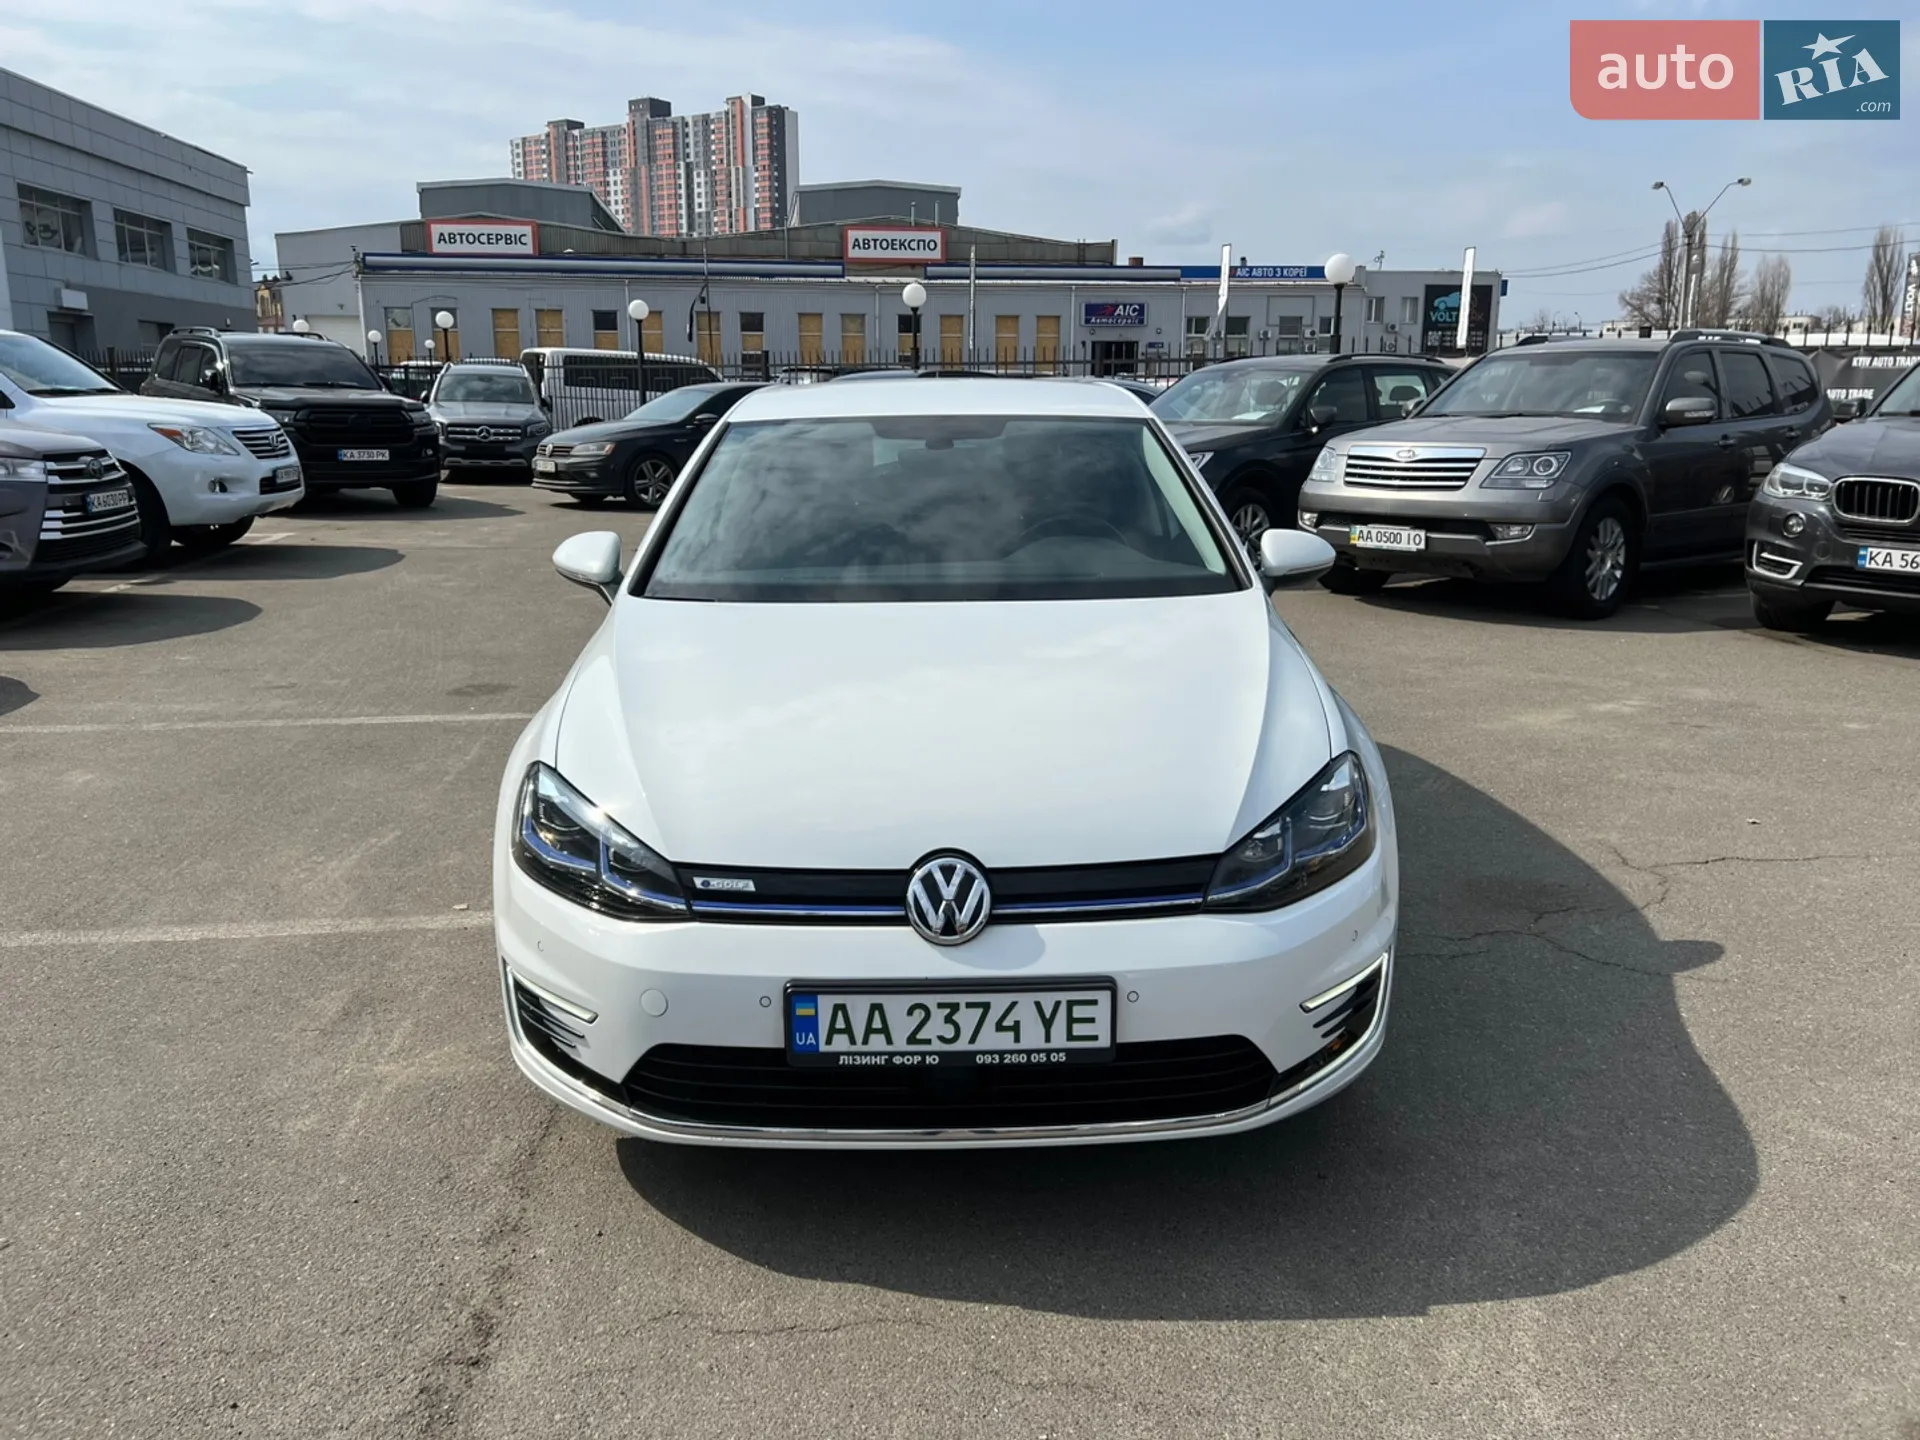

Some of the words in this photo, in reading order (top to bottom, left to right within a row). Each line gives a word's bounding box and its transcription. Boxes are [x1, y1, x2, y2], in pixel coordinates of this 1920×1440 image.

[437, 232, 528, 246] АВТОСЕРВІС
[852, 238, 938, 251] АВТОЕКСПО
[1251, 267, 1274, 277] АВТО
[1283, 266, 1307, 277] КОРЕЇ
[1852, 356, 1871, 367] KYIV
[1872, 356, 1894, 367] AUTO
[343, 450, 354, 459] KA
[1358, 529, 1373, 542] AA
[1376, 530, 1402, 545] 0500
[1868, 551, 1893, 567] KA
[825, 1002, 894, 1046] AA
[906, 1000, 1021, 1046] 2374
[1033, 999, 1099, 1044] YE
[796, 1032, 816, 1046] UA
[839, 1055, 889, 1066] ЛІЗИНГ
[892, 1054, 923, 1066] ФОР
[925, 1054, 940, 1065] Ю
[976, 1054, 1000, 1065] 093
[1003, 1053, 1027, 1064] 260
[1031, 1053, 1047, 1064] 05
[1050, 1052, 1066, 1063] 05
